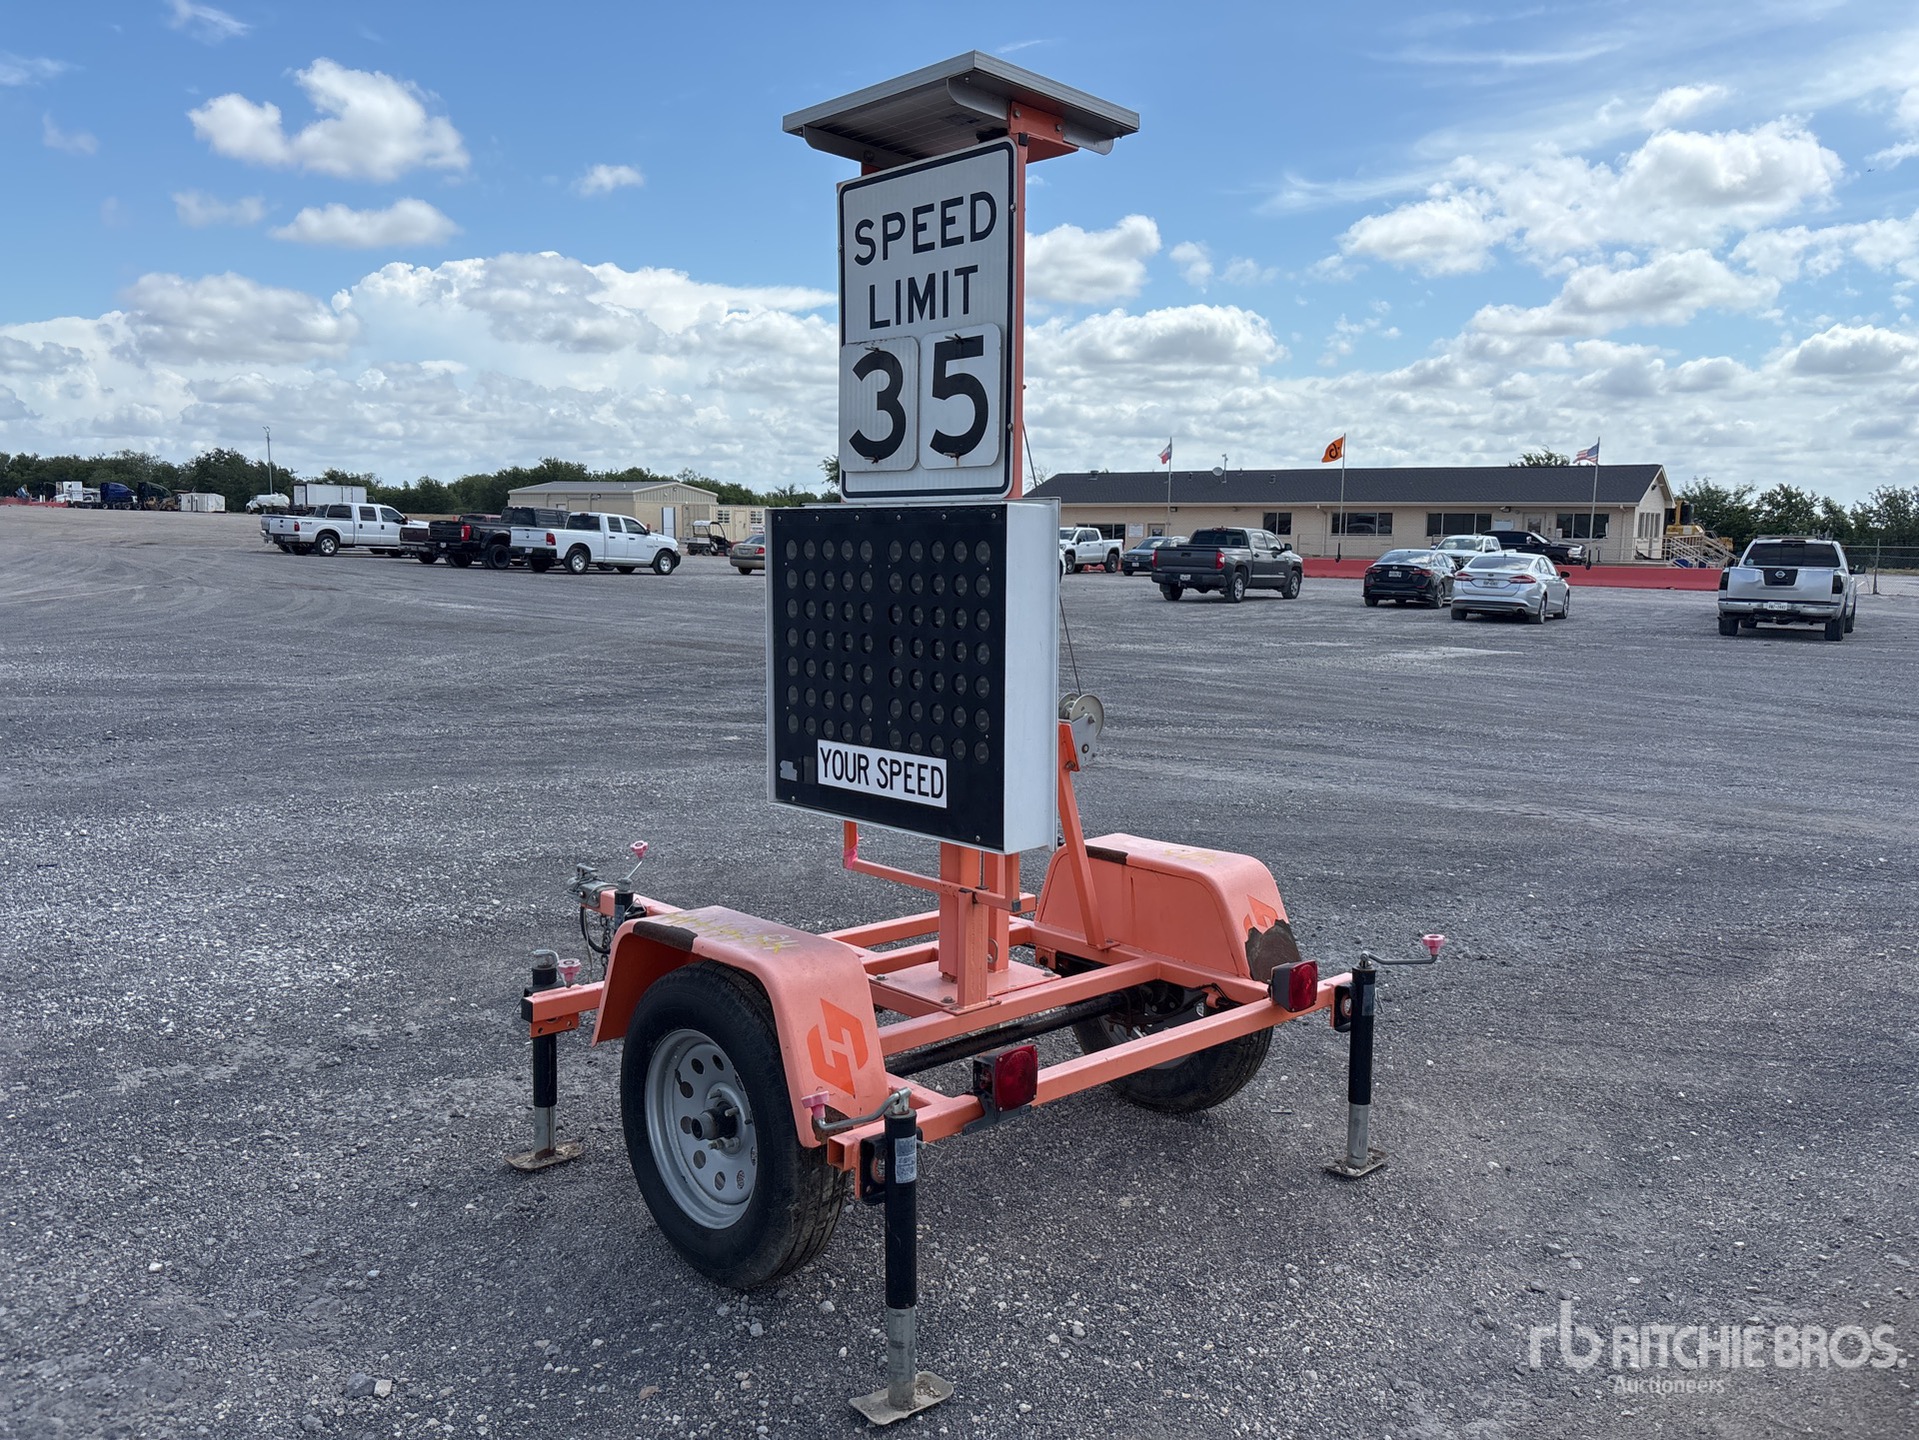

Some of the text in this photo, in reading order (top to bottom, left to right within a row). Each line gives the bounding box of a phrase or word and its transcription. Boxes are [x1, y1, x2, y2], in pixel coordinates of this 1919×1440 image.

[854, 190, 997, 267] SPEED
[869, 264, 979, 330] LIMIT
[848, 334, 989, 461] 35
[820, 747, 945, 799] YOUR SPEED
